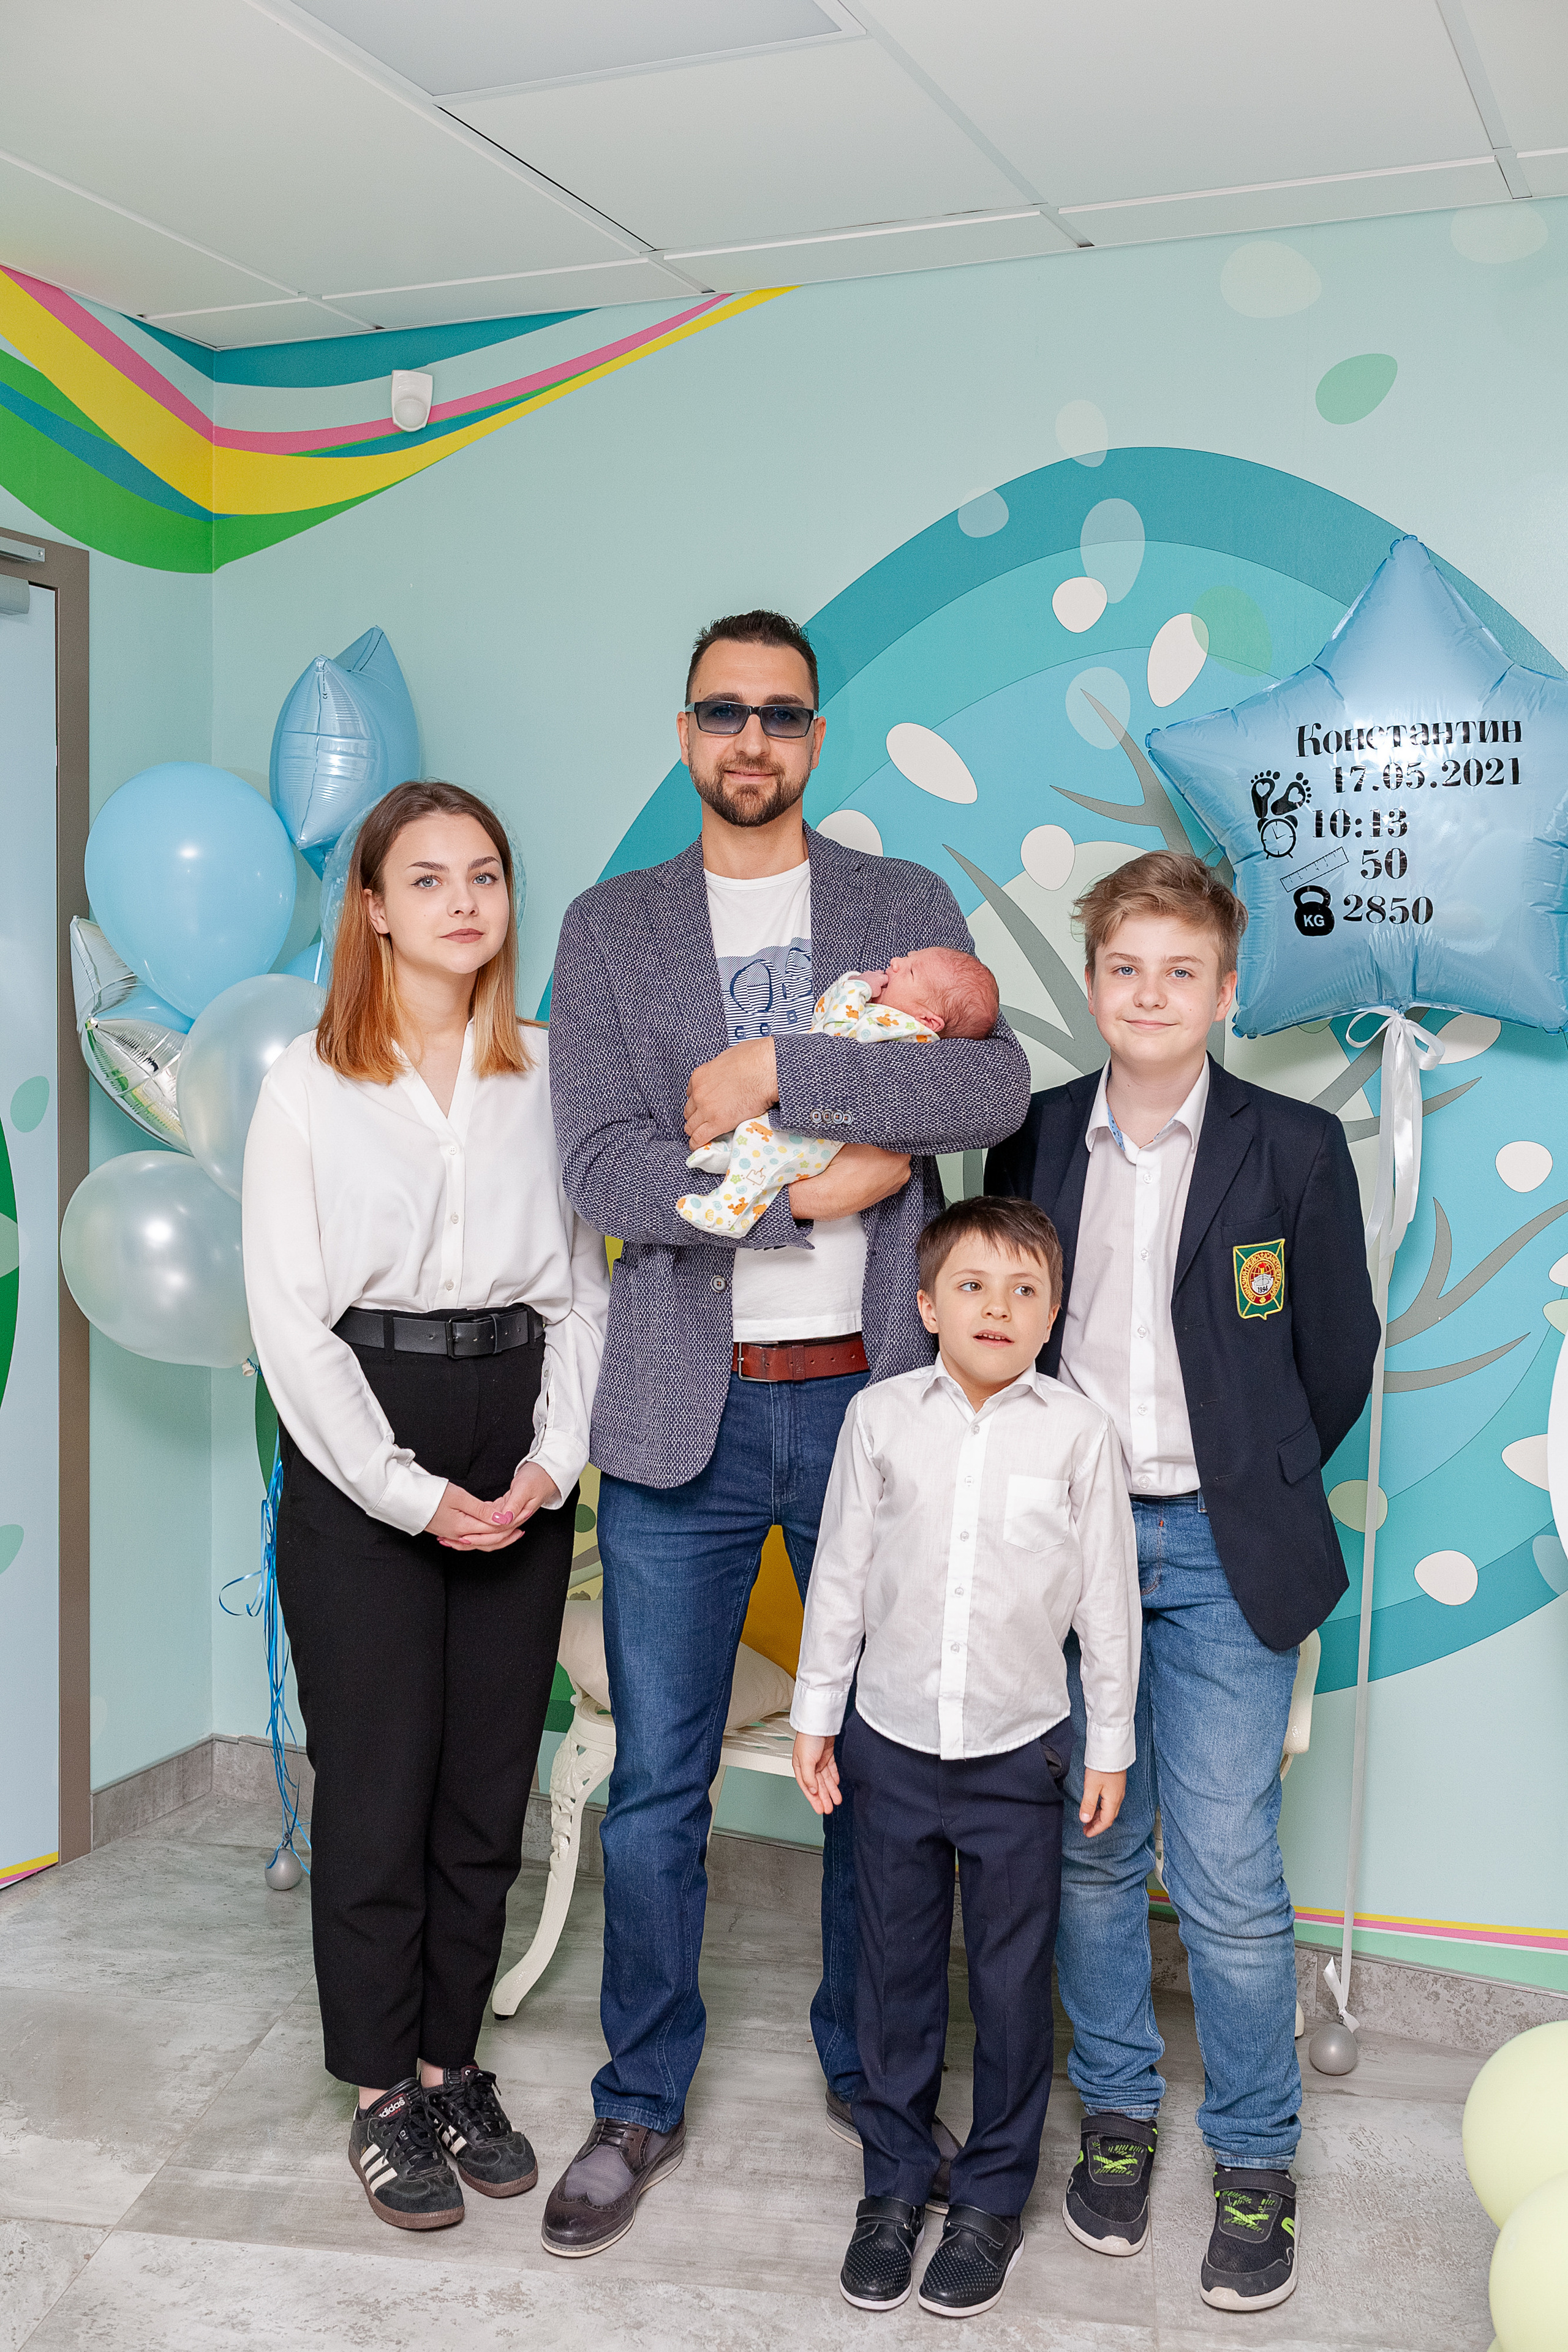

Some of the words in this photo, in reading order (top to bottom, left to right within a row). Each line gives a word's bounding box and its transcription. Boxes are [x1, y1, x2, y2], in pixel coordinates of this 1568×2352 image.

[1295, 720, 1522, 757] Константин
[1332, 758, 1522, 794] 17.05.2021
[1312, 808, 1408, 839] 10:13
[1360, 848, 1408, 880] 50
[1303, 914, 1325, 927] KG
[1343, 894, 1433, 925] 2850
